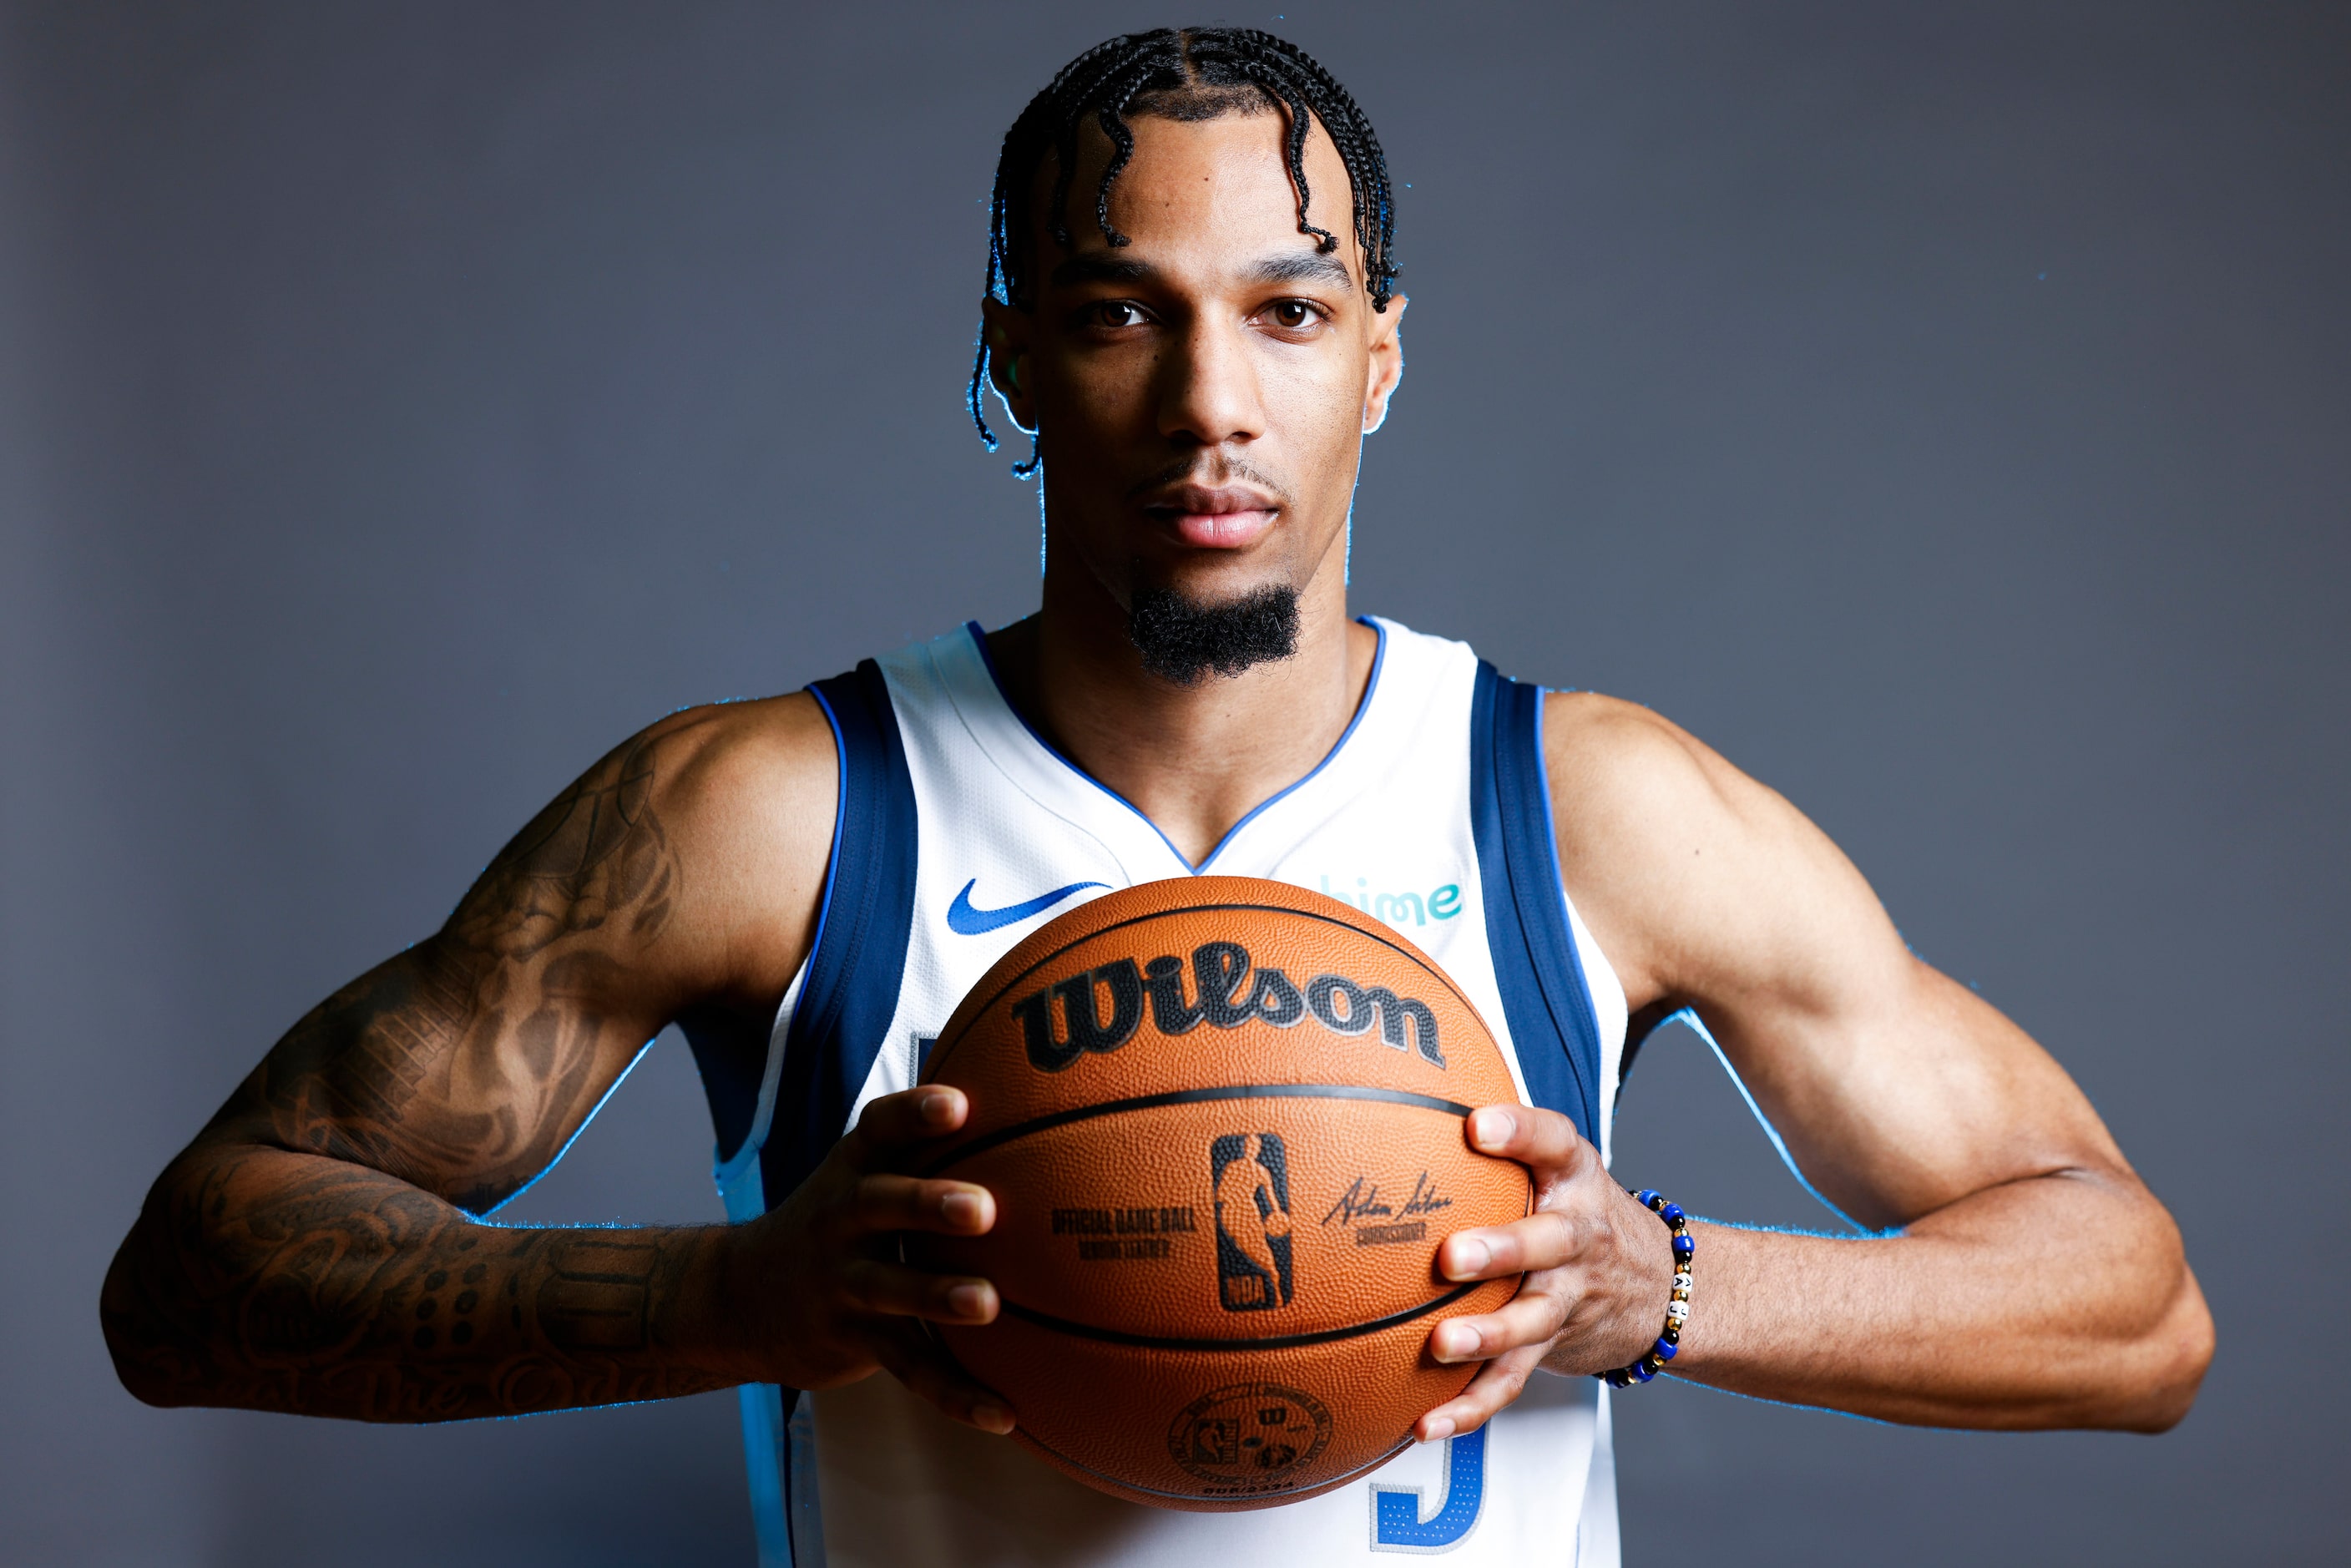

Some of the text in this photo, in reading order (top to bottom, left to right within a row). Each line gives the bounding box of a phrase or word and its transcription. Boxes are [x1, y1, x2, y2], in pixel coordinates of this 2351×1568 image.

[1320, 875, 1463, 927] hime
[1011, 940, 1447, 1073] Wilson
[1160, 1207, 1196, 1233] BALL
[1226, 1274, 1267, 1305] NBA
